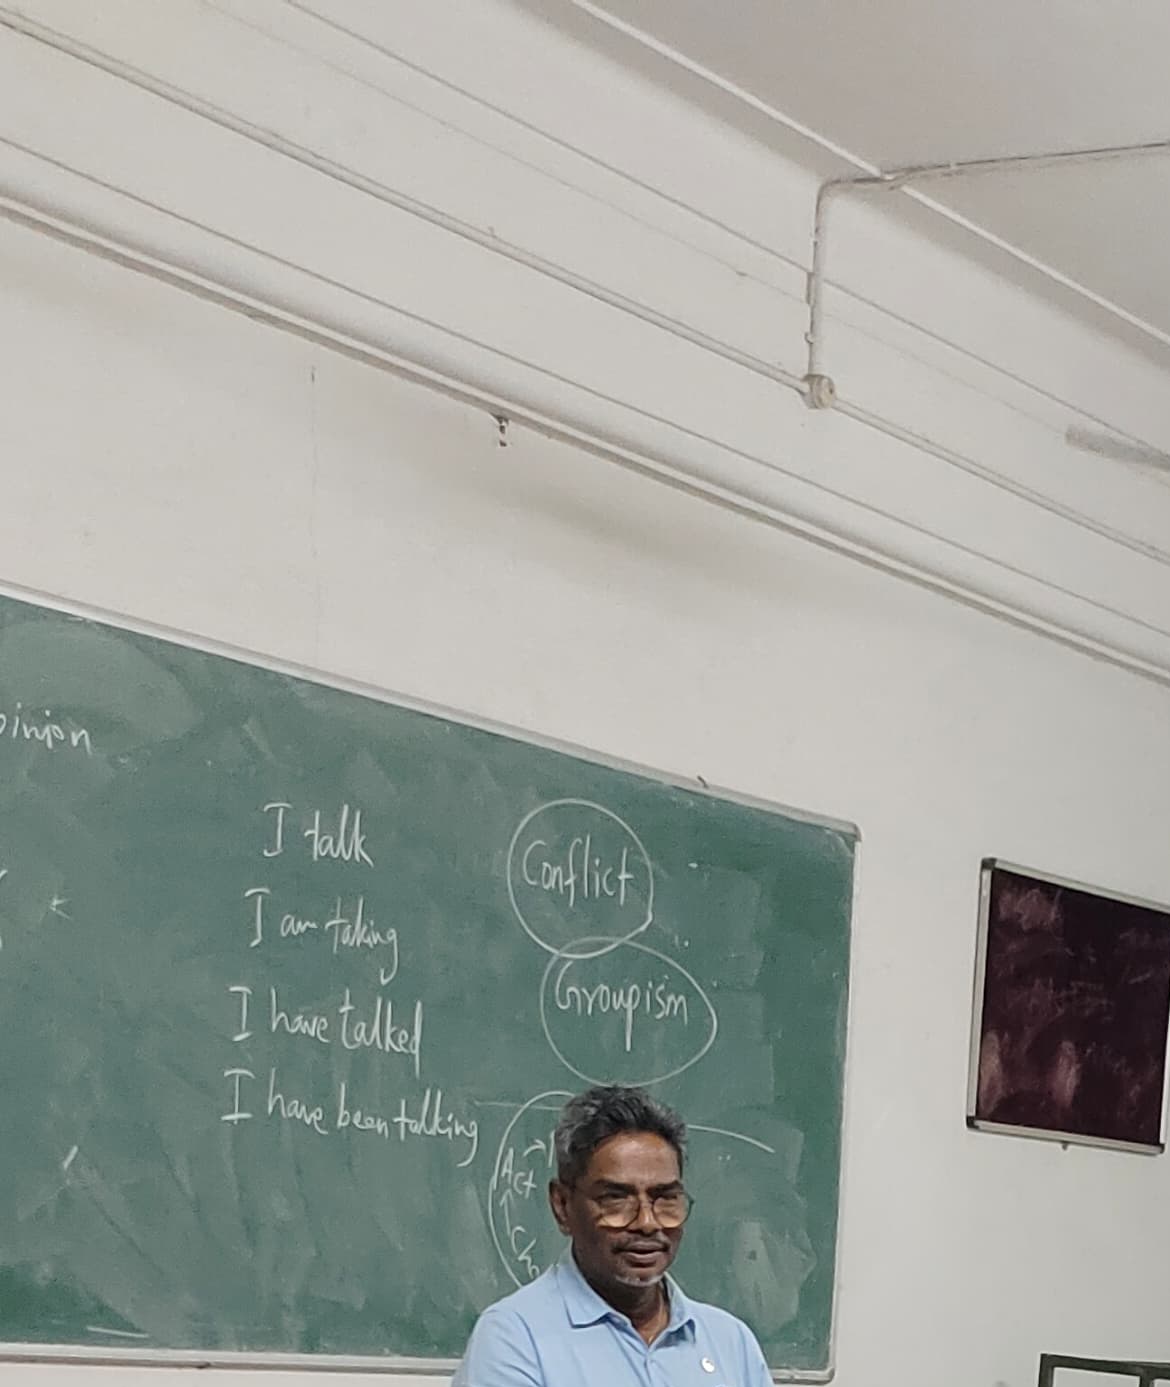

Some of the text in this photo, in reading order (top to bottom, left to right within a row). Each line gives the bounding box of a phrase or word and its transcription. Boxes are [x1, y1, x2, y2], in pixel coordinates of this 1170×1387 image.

[264, 803, 374, 868] I talk
[523, 833, 634, 907] Conflict
[245, 888, 271, 947] I
[229, 985, 422, 1079] I have talked
[555, 961, 688, 1051] Groupism
[221, 1069, 255, 1124] I
[267, 1067, 329, 1134] have
[337, 1082, 389, 1139] been
